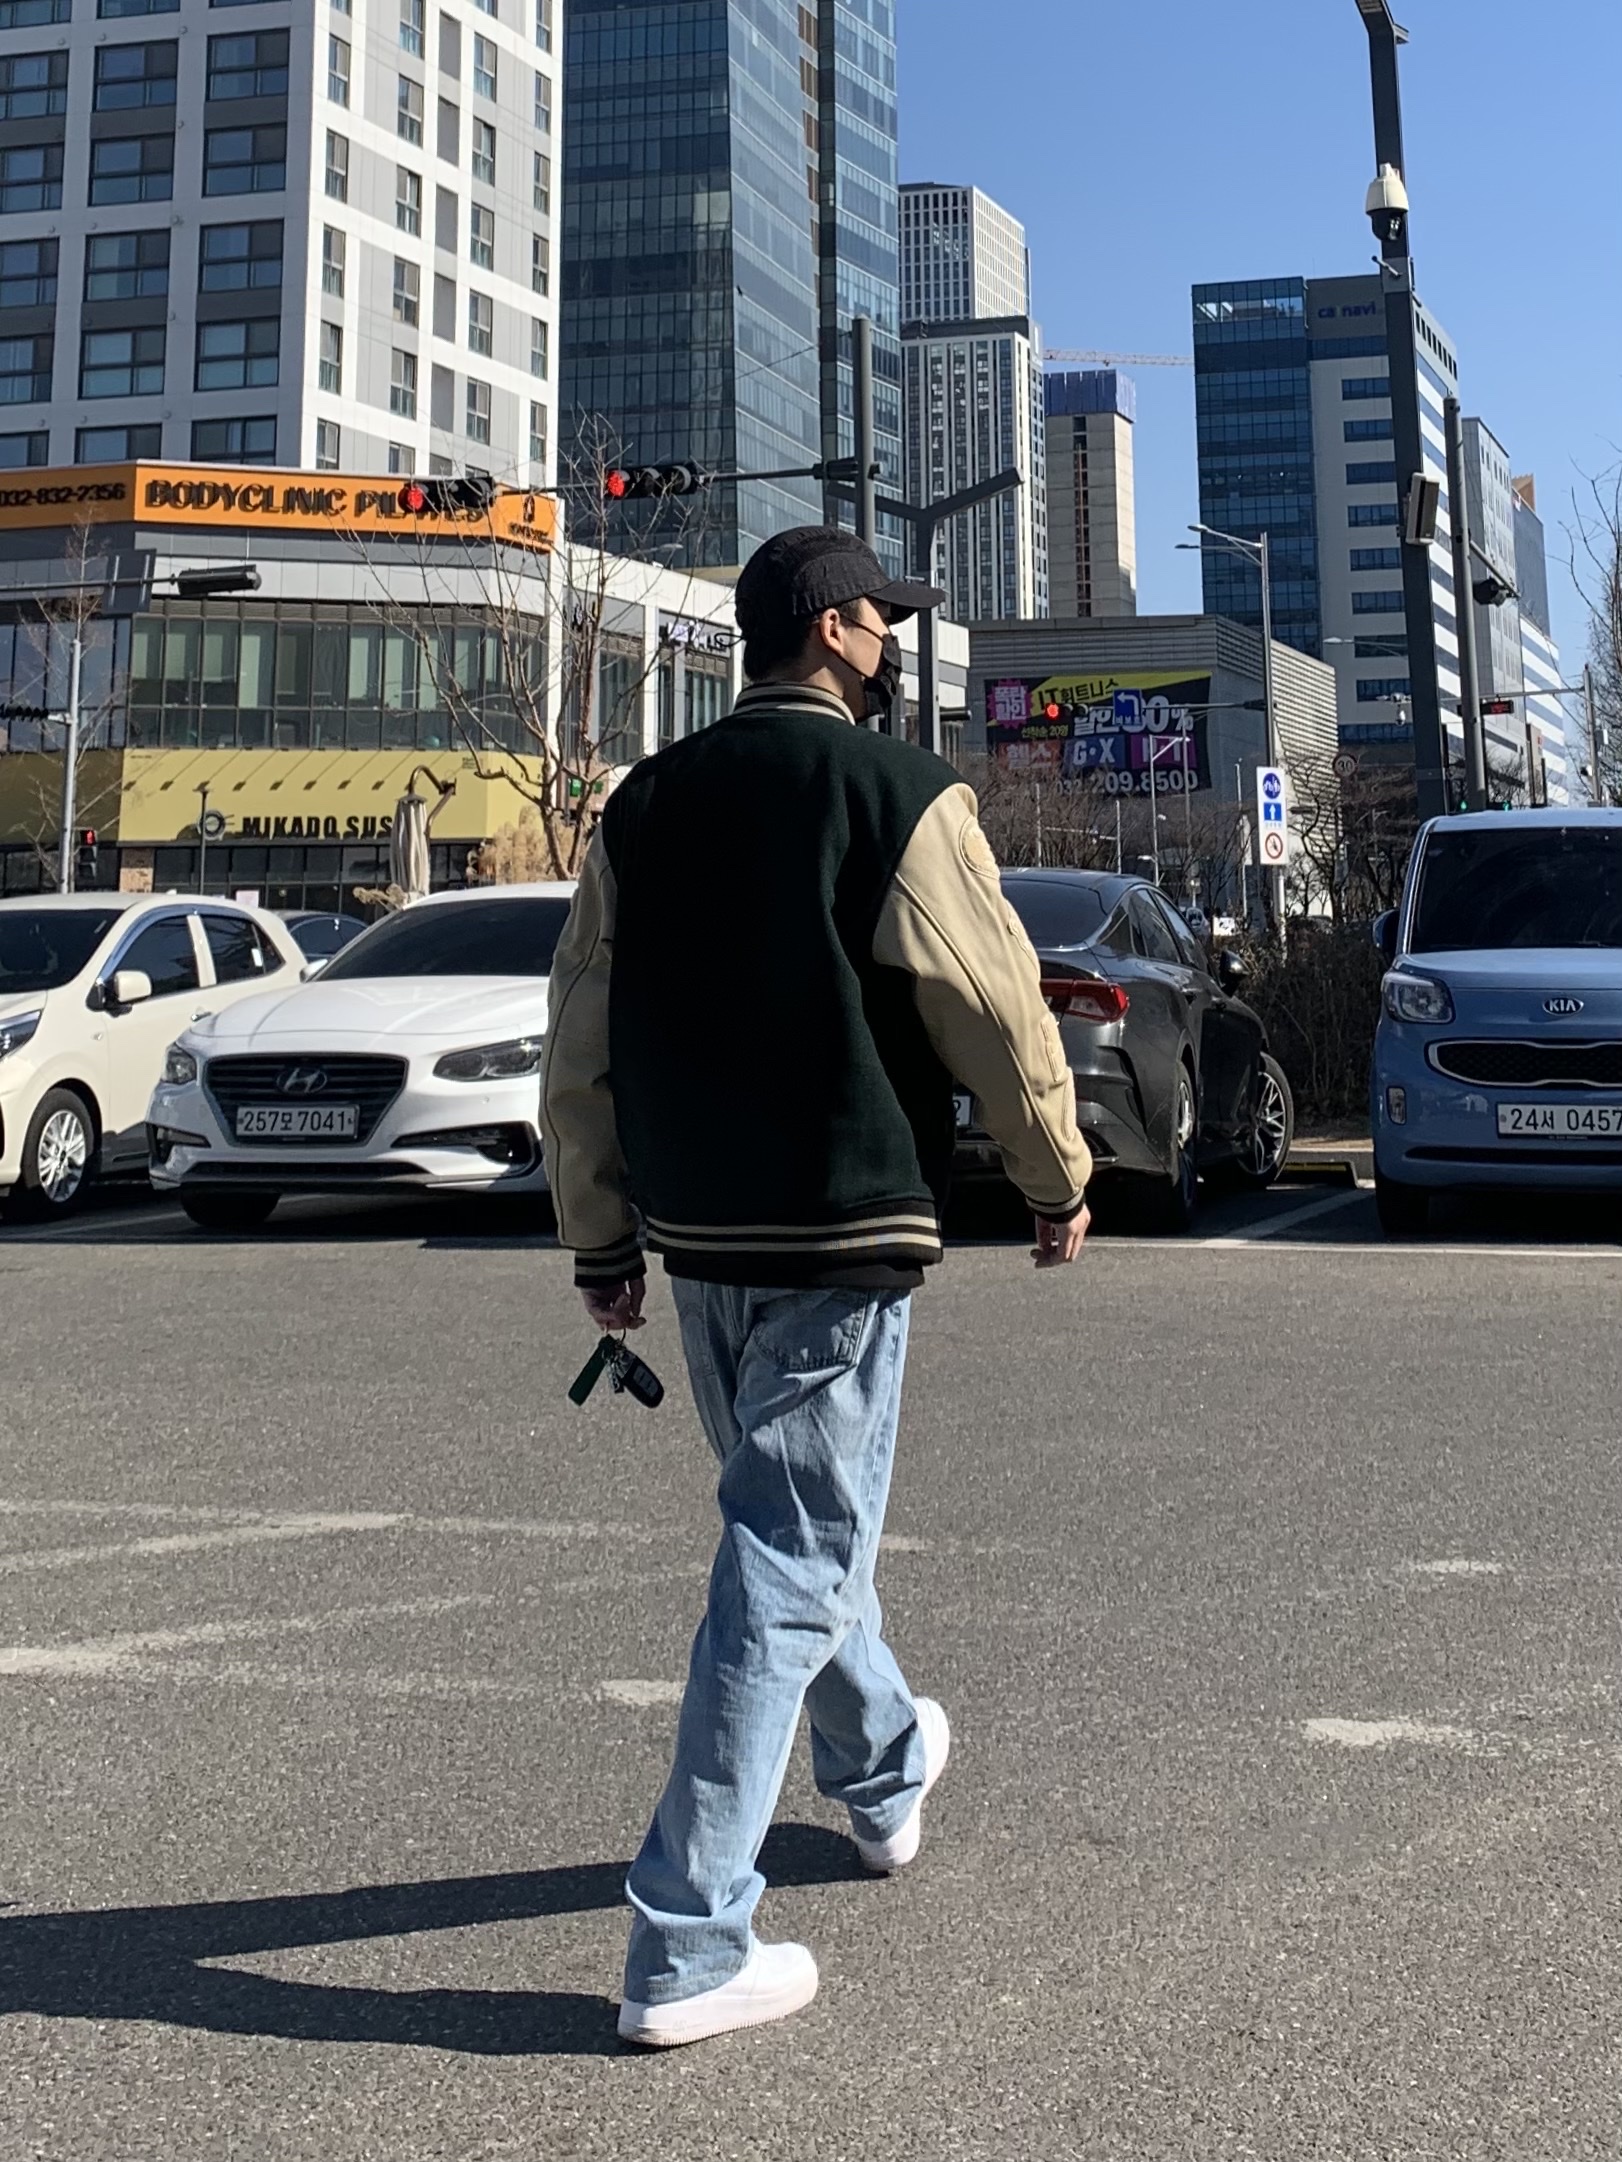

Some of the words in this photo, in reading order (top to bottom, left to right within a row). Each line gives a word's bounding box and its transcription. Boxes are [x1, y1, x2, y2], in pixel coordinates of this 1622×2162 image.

[145, 479, 347, 516] BODYCLINIC
[243, 816, 338, 838] MIKADO
[1549, 999, 1577, 1012] KIA
[297, 1111, 346, 1132] 7041
[1511, 1108, 1554, 1132] 24서
[1566, 1108, 1622, 1133] 0457
